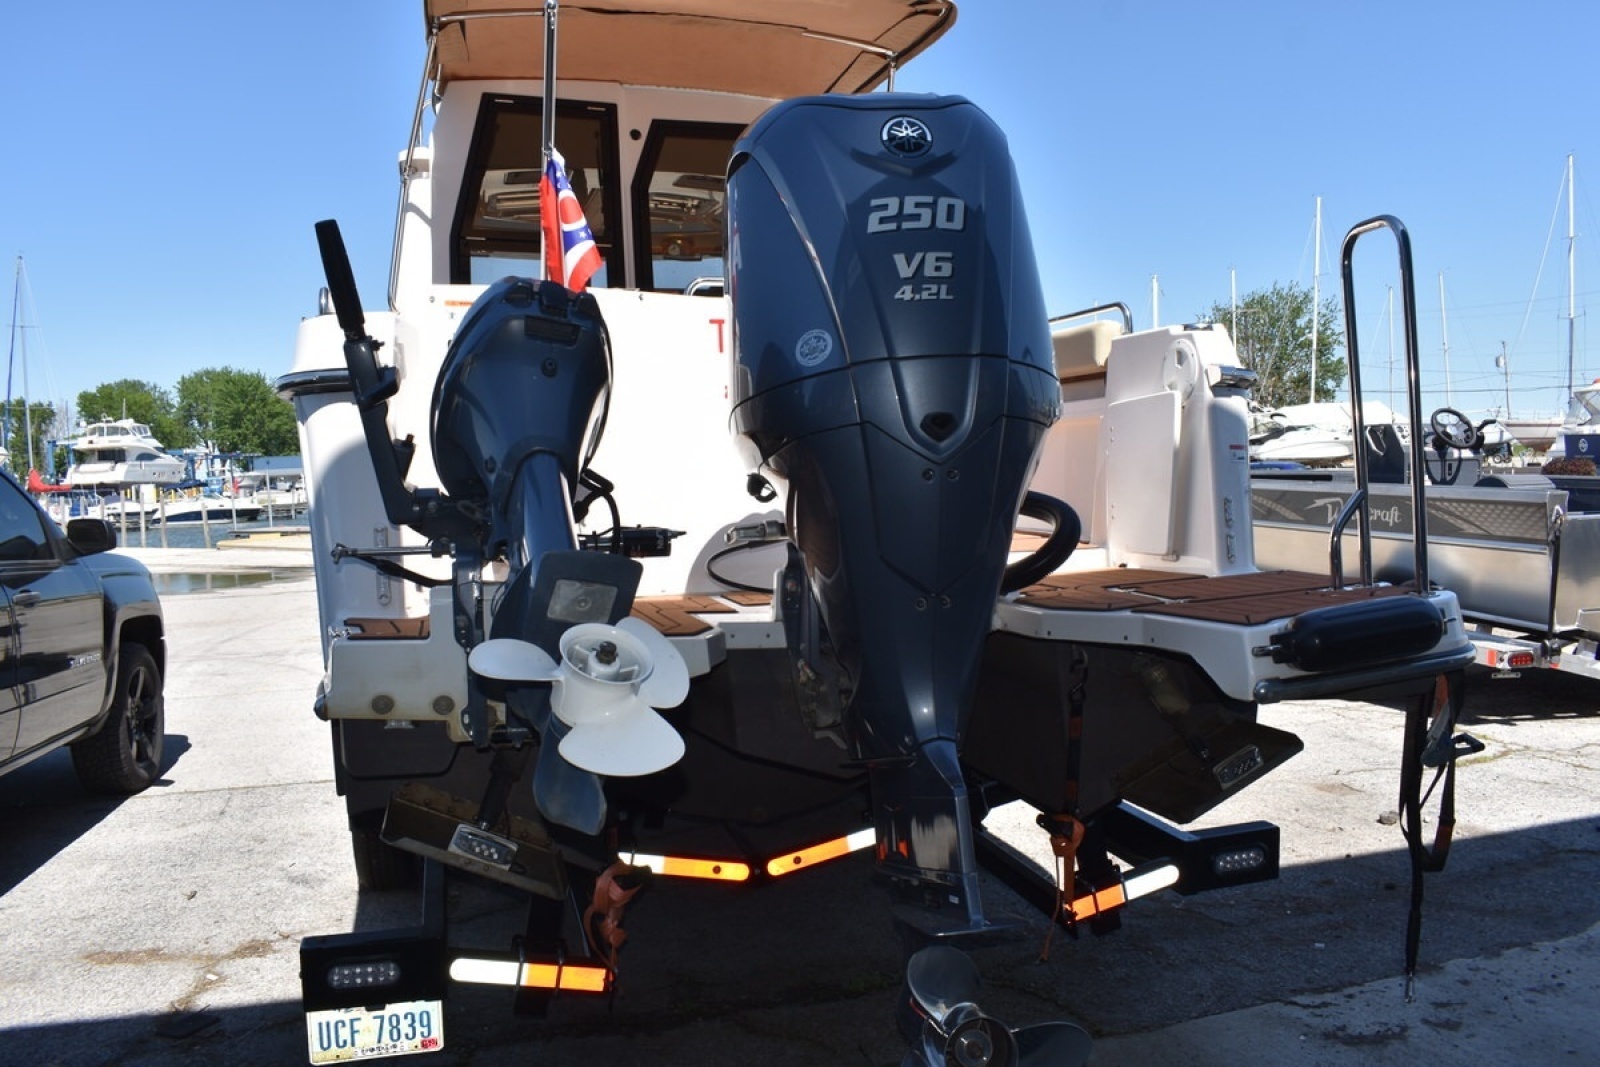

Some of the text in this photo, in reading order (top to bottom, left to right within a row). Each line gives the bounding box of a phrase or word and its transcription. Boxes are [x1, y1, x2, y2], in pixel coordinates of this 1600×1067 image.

[867, 196, 965, 233] 250
[892, 252, 954, 278] V6
[318, 1017, 361, 1051] UCF
[373, 1010, 432, 1044] 7839
